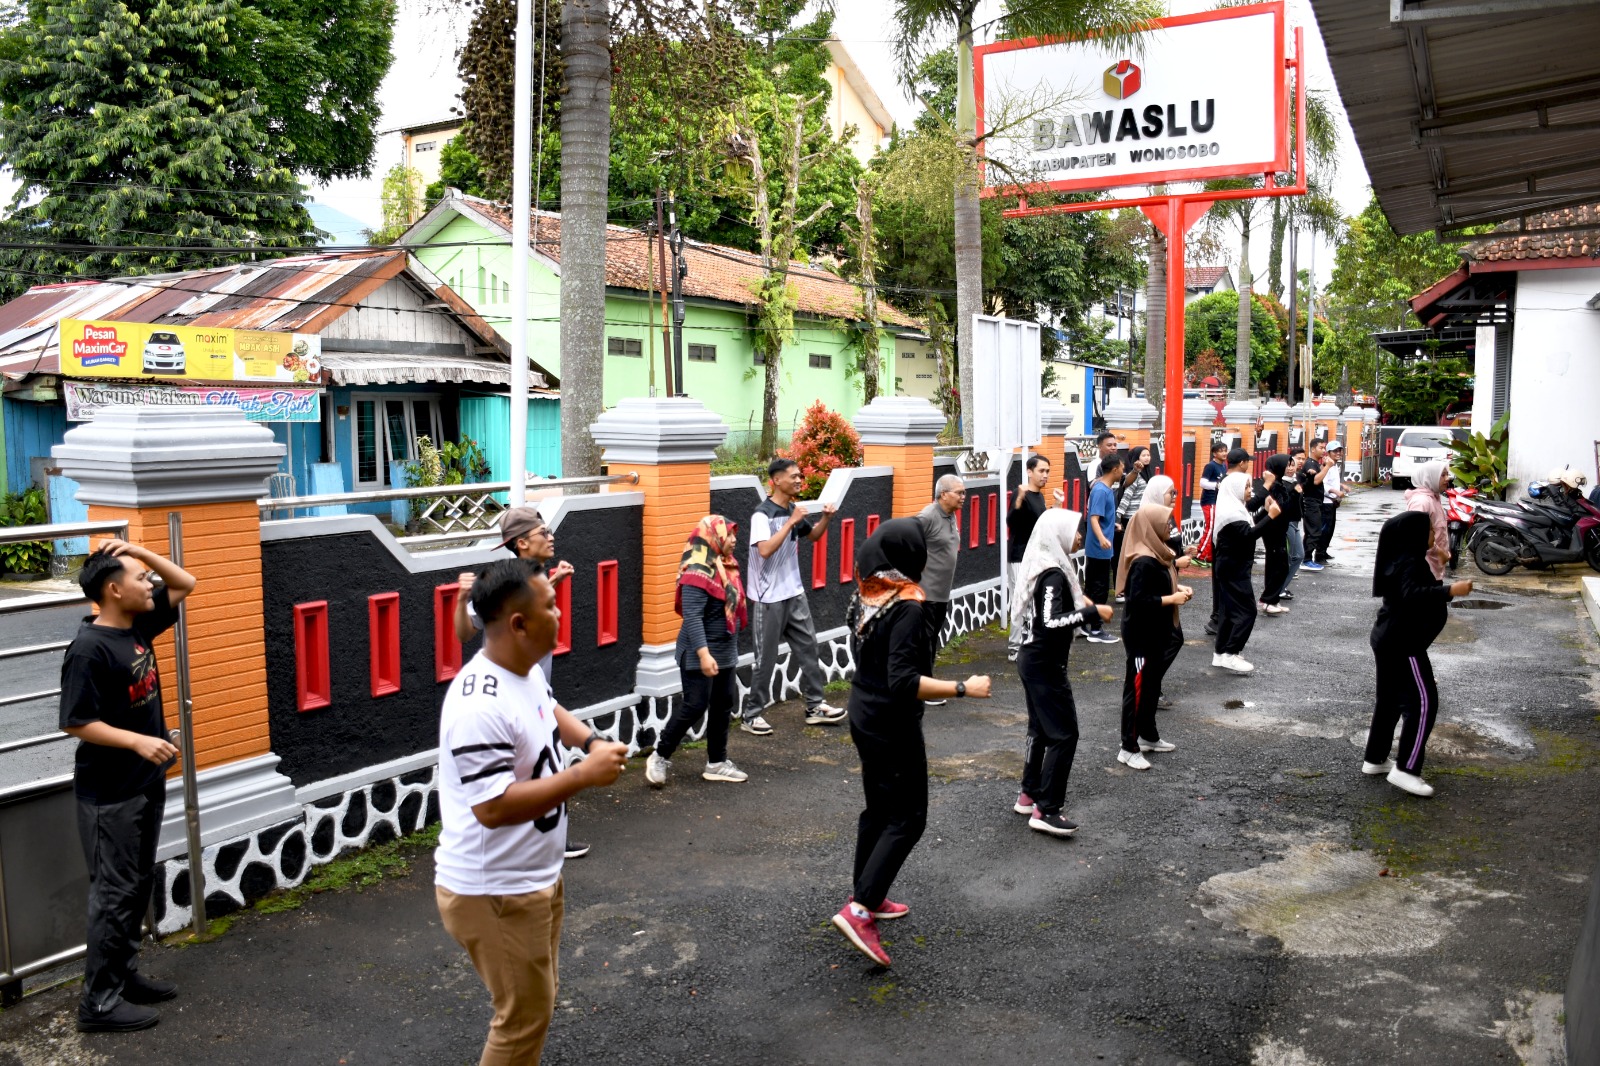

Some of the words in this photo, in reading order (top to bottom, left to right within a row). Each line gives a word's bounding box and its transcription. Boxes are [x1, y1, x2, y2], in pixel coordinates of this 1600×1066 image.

[1033, 99, 1215, 151] BAWASLU
[1030, 153, 1116, 172] KABUPATEN
[1130, 142, 1220, 163] WONOSOBO
[85, 328, 115, 340] Pesan
[195, 333, 227, 344] maxim
[74, 342, 126, 355] MaximCar
[240, 343, 260, 351] MBAK
[263, 345, 280, 353] ASIH
[75, 387, 145, 405] Warung
[149, 389, 200, 405] Makan
[266, 391, 313, 419] Asih
[462, 673, 499, 698] 82
